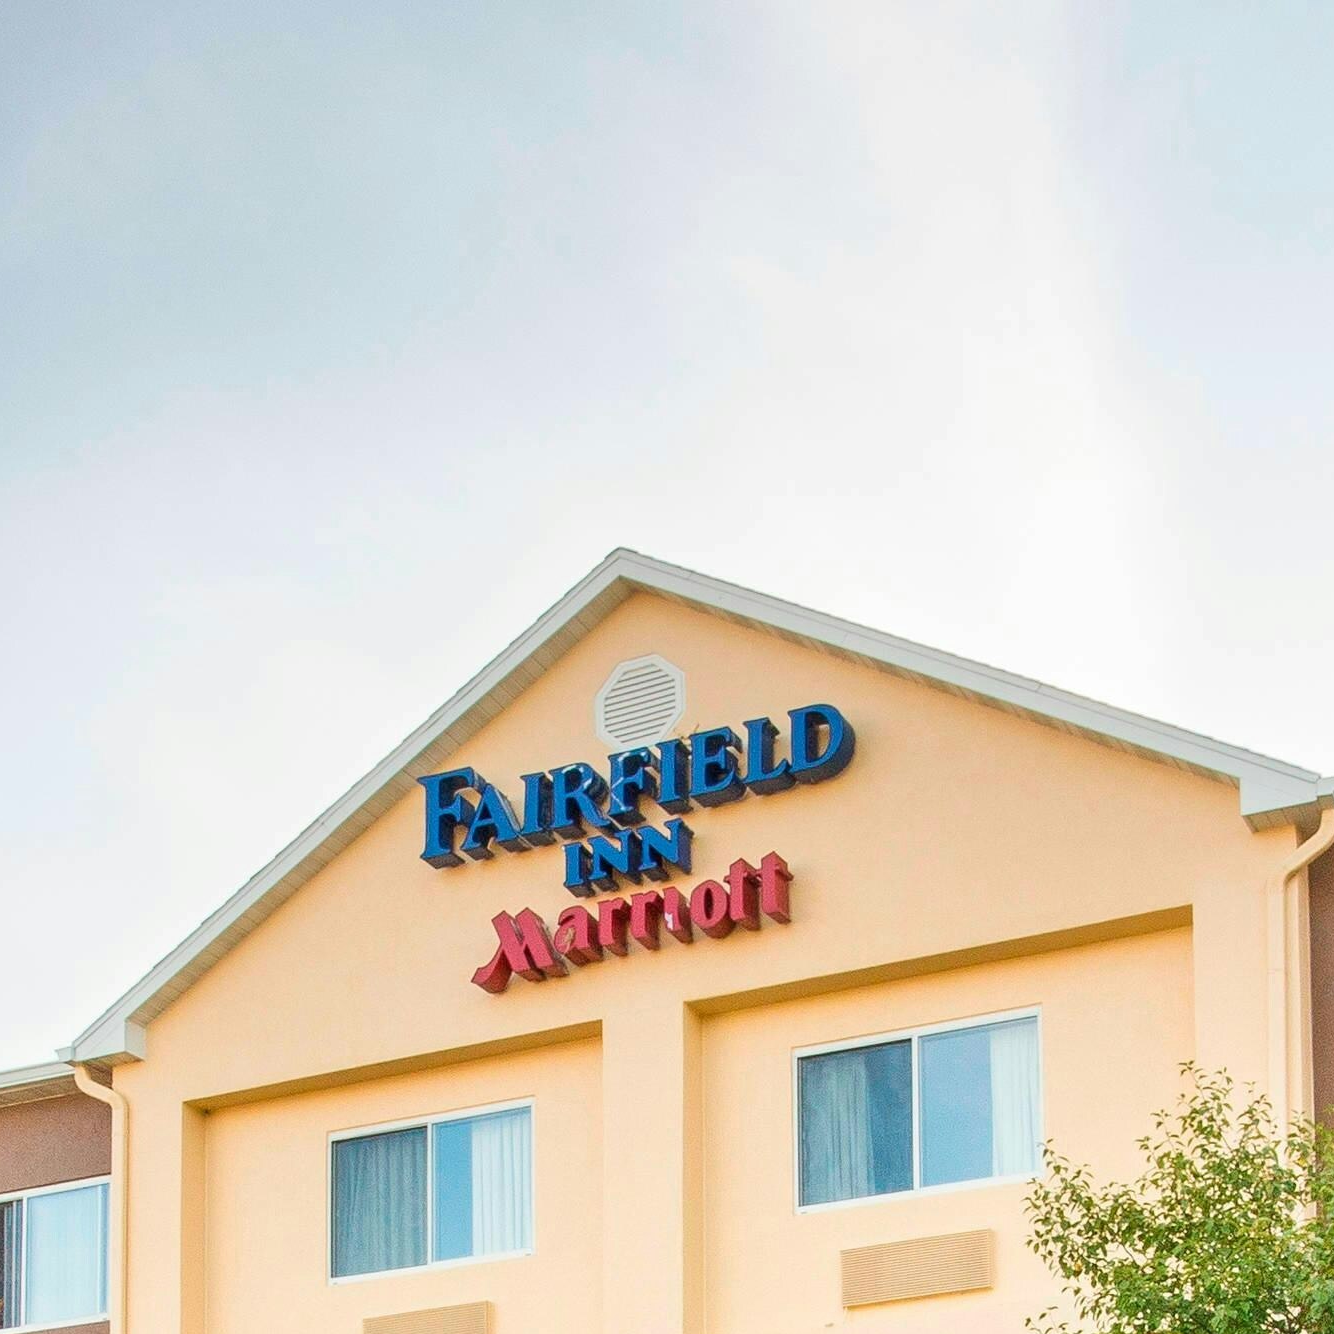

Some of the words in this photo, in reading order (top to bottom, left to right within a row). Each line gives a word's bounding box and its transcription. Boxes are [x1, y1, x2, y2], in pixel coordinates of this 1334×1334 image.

[417, 703, 856, 868] FAIRFIELD
[471, 851, 794, 993] Marriott
[563, 818, 694, 898] INN
